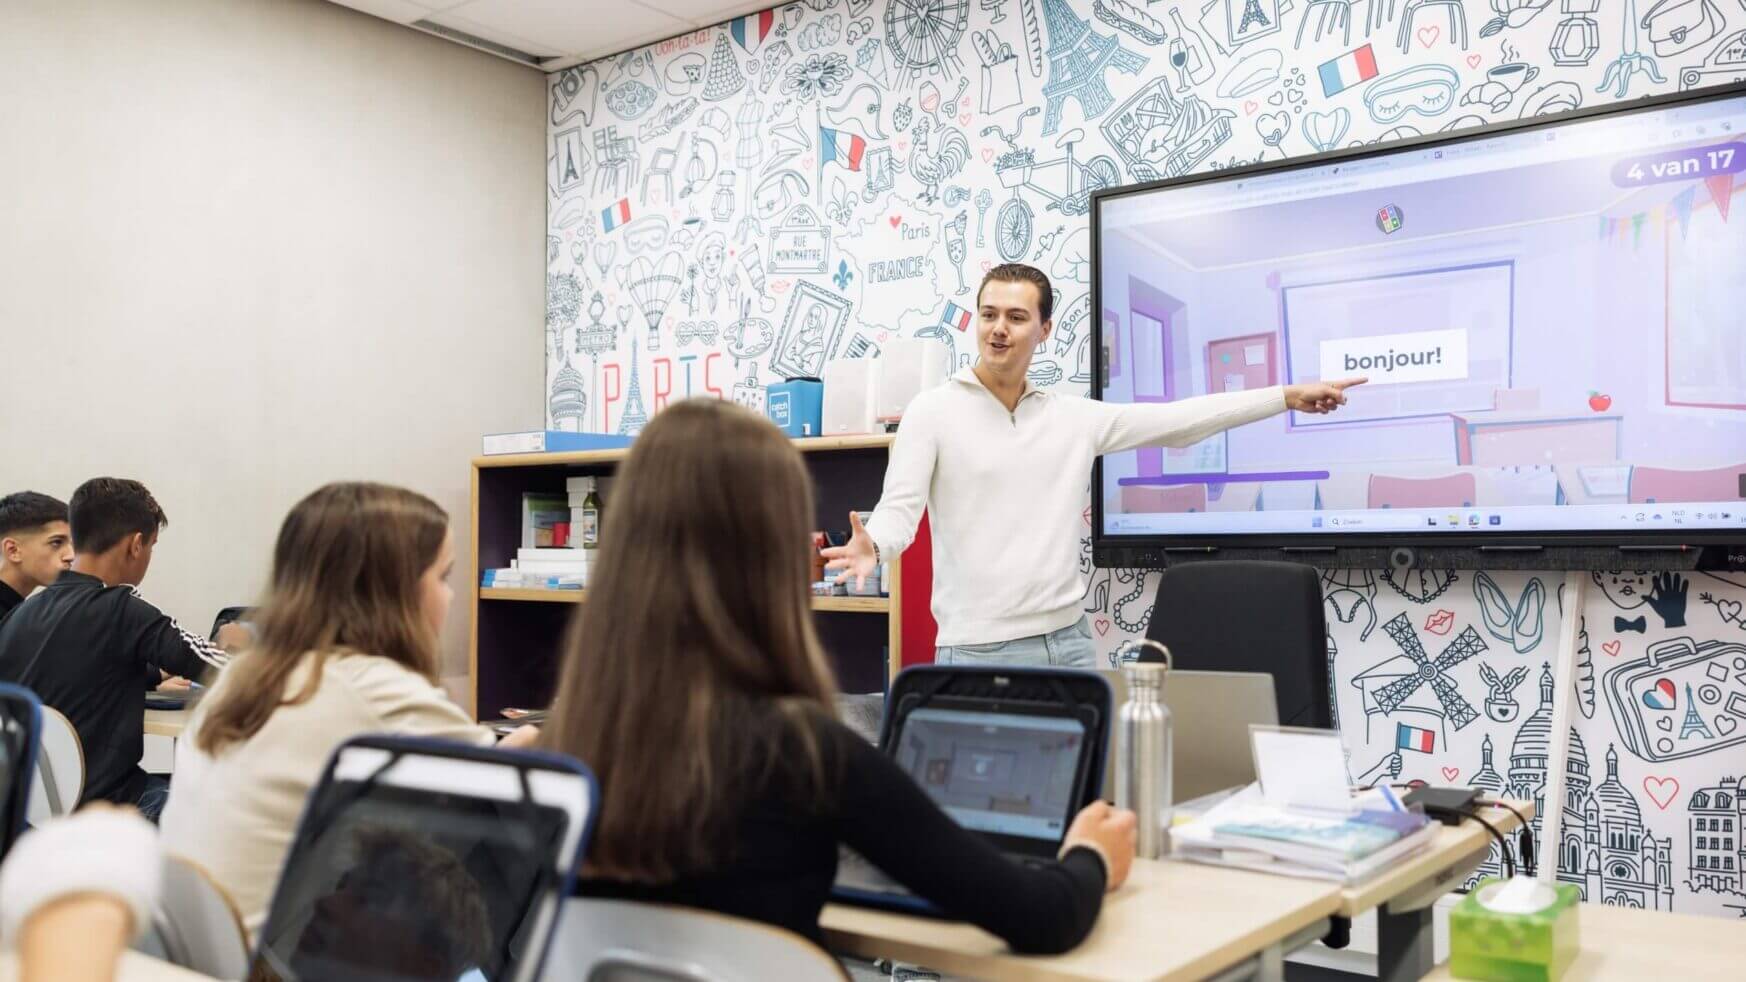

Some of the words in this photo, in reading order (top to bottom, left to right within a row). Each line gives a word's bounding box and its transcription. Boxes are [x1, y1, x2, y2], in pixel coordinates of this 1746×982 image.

[1626, 163, 1645, 180] 4
[1650, 157, 1700, 178] van
[1707, 149, 1736, 170] 17
[793, 235, 807, 248] RUE
[901, 222, 931, 241] Paris
[775, 248, 822, 262] MONTMARTRE
[868, 255, 925, 284] FRANCE
[1061, 309, 1081, 331] Bon
[1344, 346, 1442, 372] bonjour!
